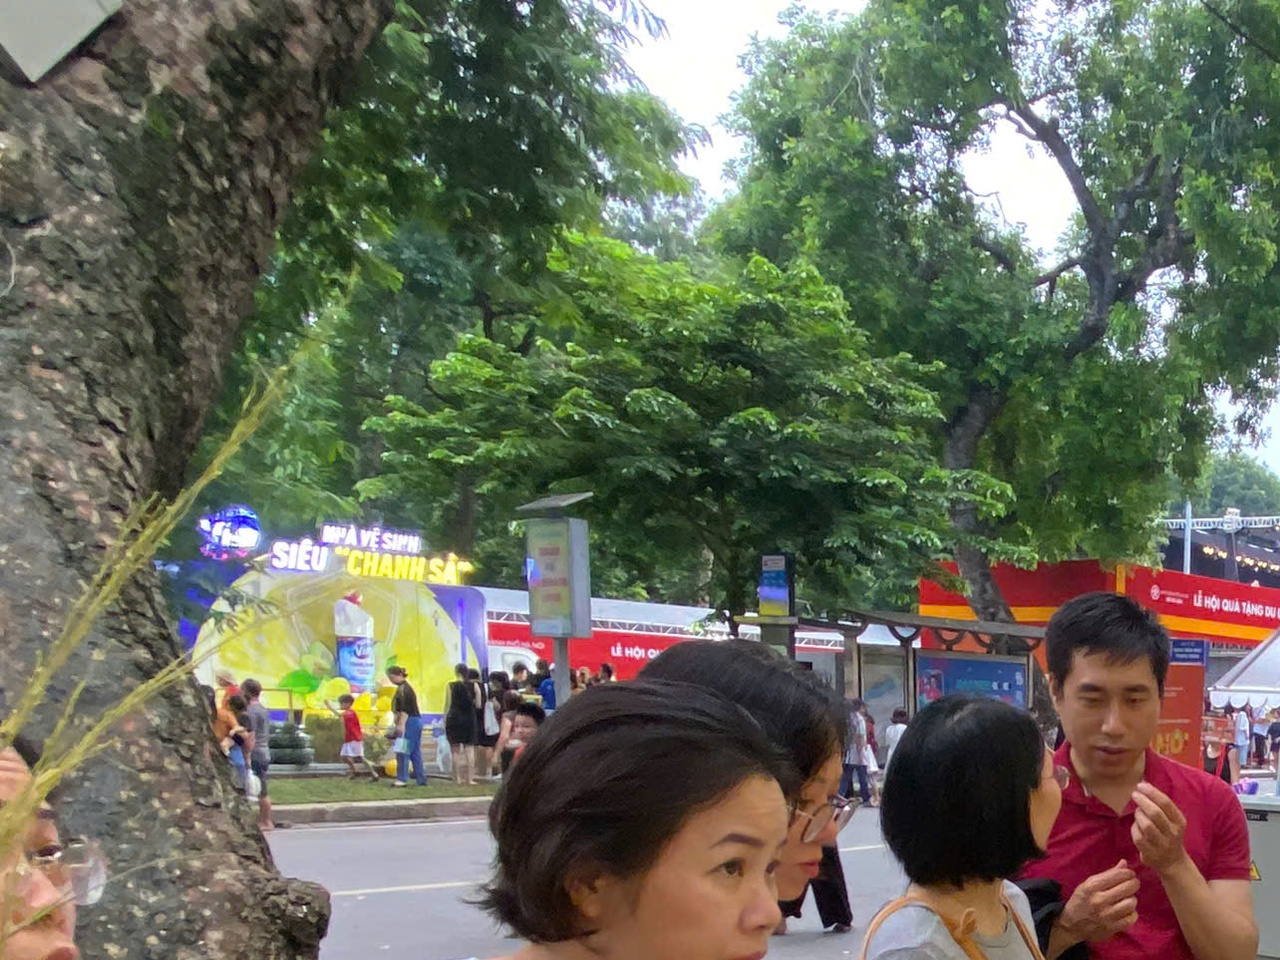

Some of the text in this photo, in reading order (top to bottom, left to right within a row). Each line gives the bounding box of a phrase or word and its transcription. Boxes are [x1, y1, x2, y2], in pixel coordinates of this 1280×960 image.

[272, 537, 329, 571] SIÊU
[360, 527, 381, 551] VỆ
[382, 532, 420, 554] SINH
[1194, 590, 1202, 607] LỄ
[1204, 594, 1220, 612] HỘI
[1222, 596, 1240, 613] QUÀ
[1265, 605, 1276, 618] DU
[611, 641, 622, 657] LỄ
[624, 645, 645, 660] HỘI
